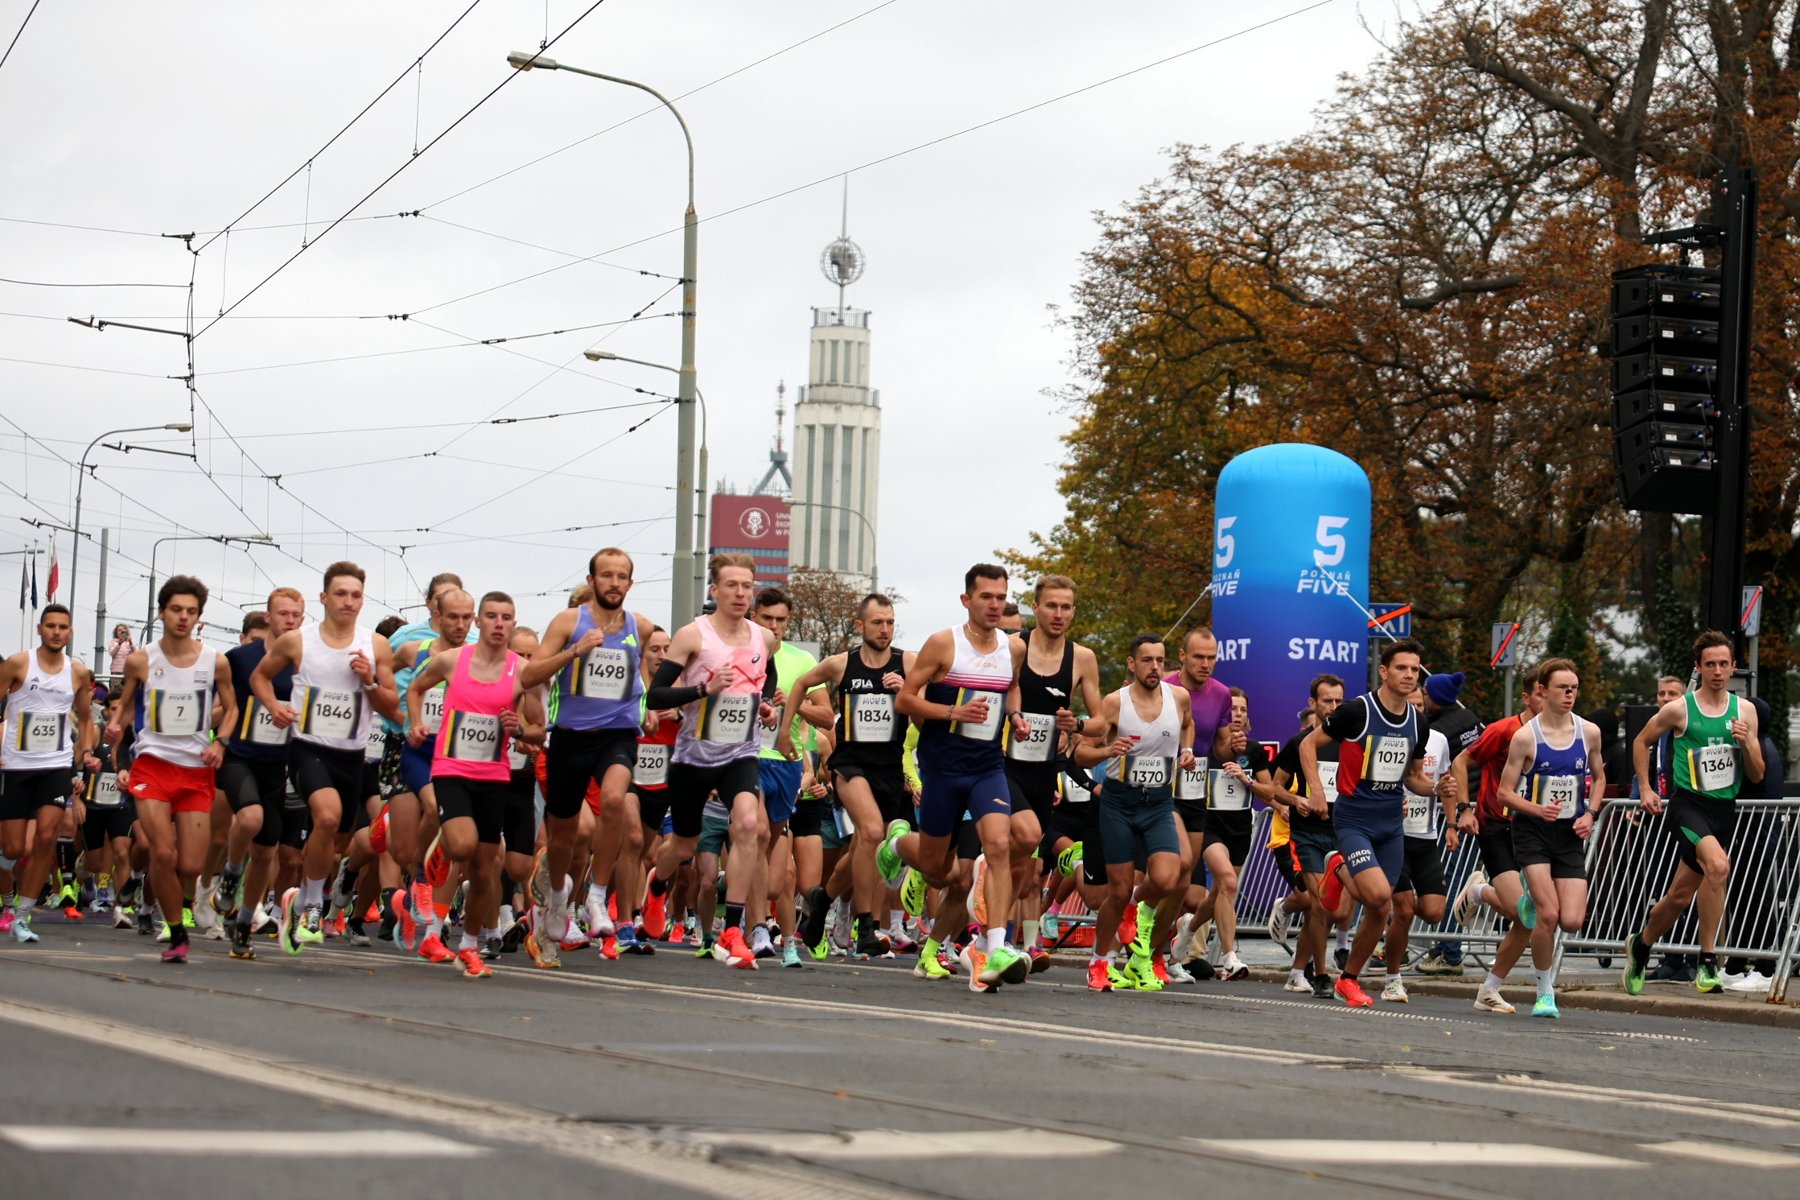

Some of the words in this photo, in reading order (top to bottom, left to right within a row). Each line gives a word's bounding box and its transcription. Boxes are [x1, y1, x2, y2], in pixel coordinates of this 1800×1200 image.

[1216, 516, 1238, 568] 5
[1313, 515, 1350, 566] 5
[1297, 578, 1350, 596] FIVE
[1368, 607, 1406, 634] AXI
[1216, 638, 1252, 662] ART
[1287, 637, 1360, 664] START
[587, 662, 626, 679] 1498
[343, 693, 350, 701] 5
[881, 697, 887, 705] 5
[176, 706, 184, 717] 7
[316, 703, 352, 720] 1846
[718, 709, 747, 723] 955
[857, 709, 891, 722] 1834
[259, 712, 273, 725] 19
[32, 725, 56, 737] 635
[460, 727, 497, 743] 1904
[1399, 740, 1405, 748] 5
[639, 757, 664, 769] 320
[1378, 750, 1406, 764] 1012
[1701, 756, 1734, 773] 1364
[1132, 770, 1164, 783] 1370
[1328, 776, 1335, 786] 4
[101, 781, 118, 792] 116
[1227, 784, 1234, 795] 5
[1549, 789, 1572, 803] 321
[1409, 806, 1427, 818] 199
